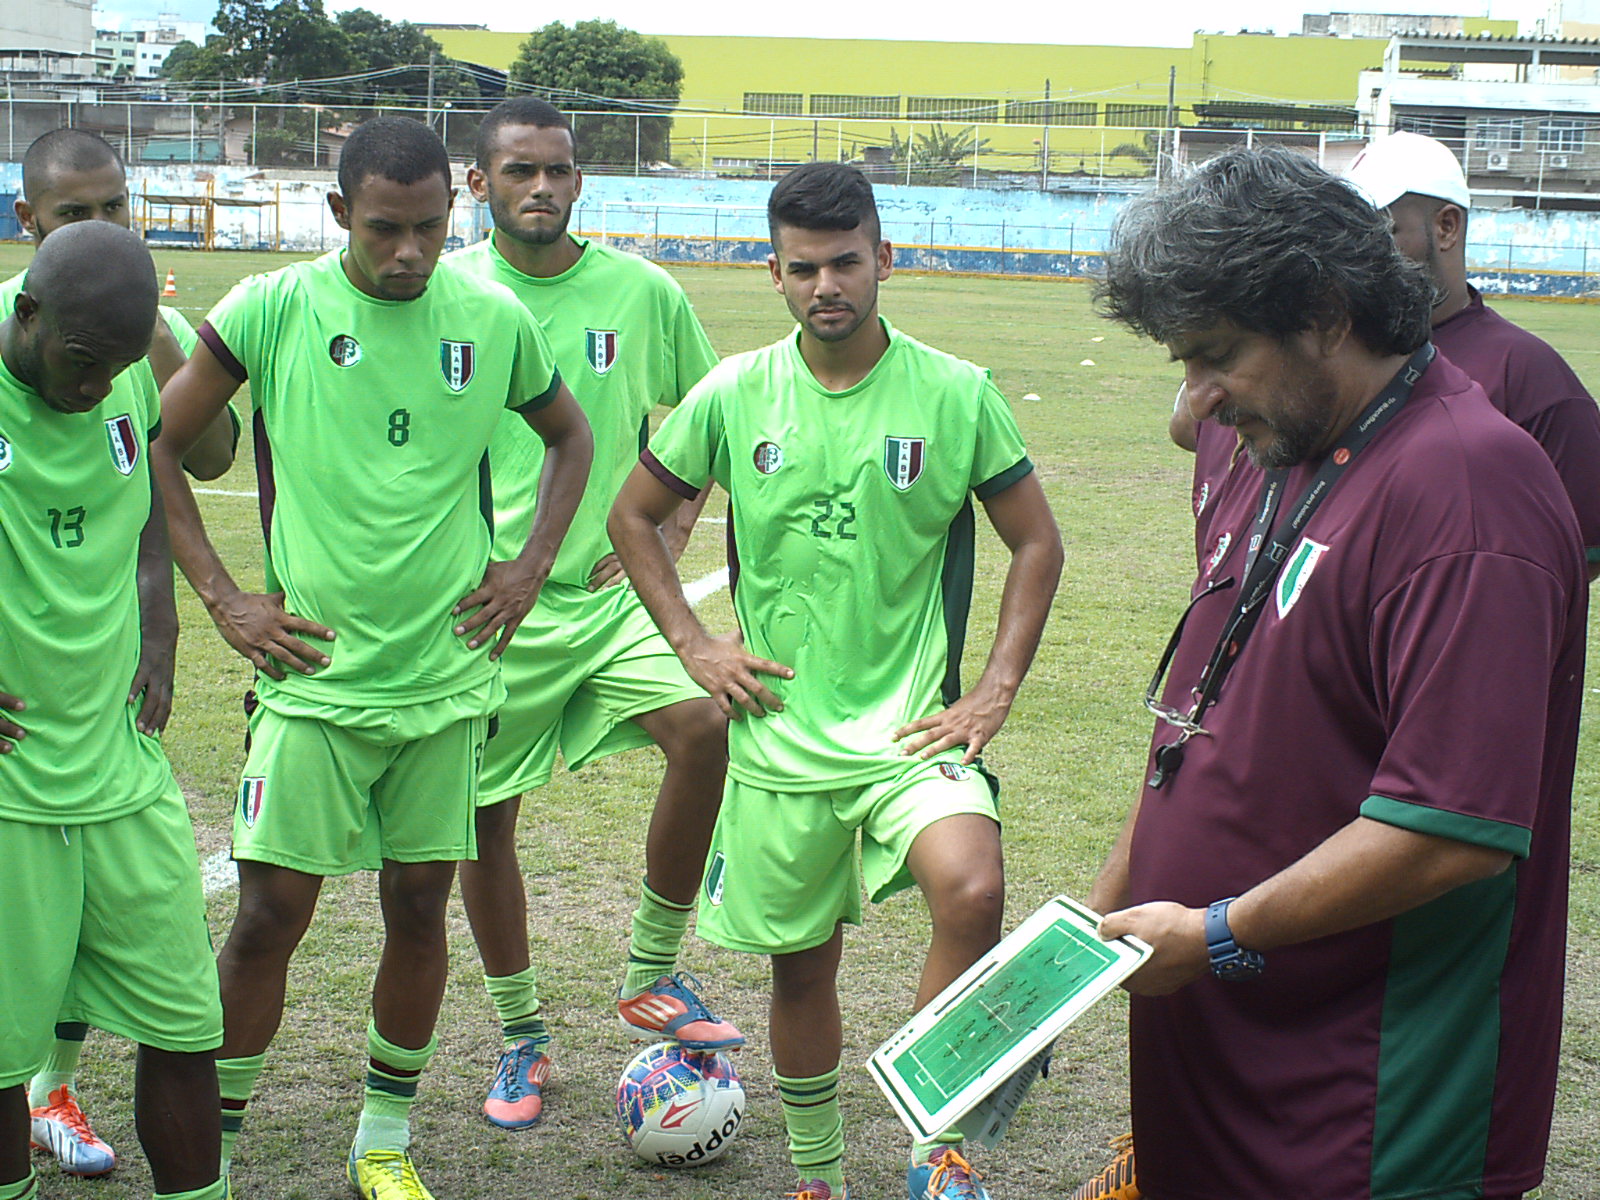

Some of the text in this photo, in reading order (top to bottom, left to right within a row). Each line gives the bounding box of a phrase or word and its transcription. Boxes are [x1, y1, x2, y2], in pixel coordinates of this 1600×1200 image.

[452, 345, 460, 386] CABT
[110, 423, 127, 469] CABT
[387, 408, 411, 447] 8
[899, 442, 909, 485] CABT
[47, 505, 87, 549] 13
[810, 499, 858, 541] 22
